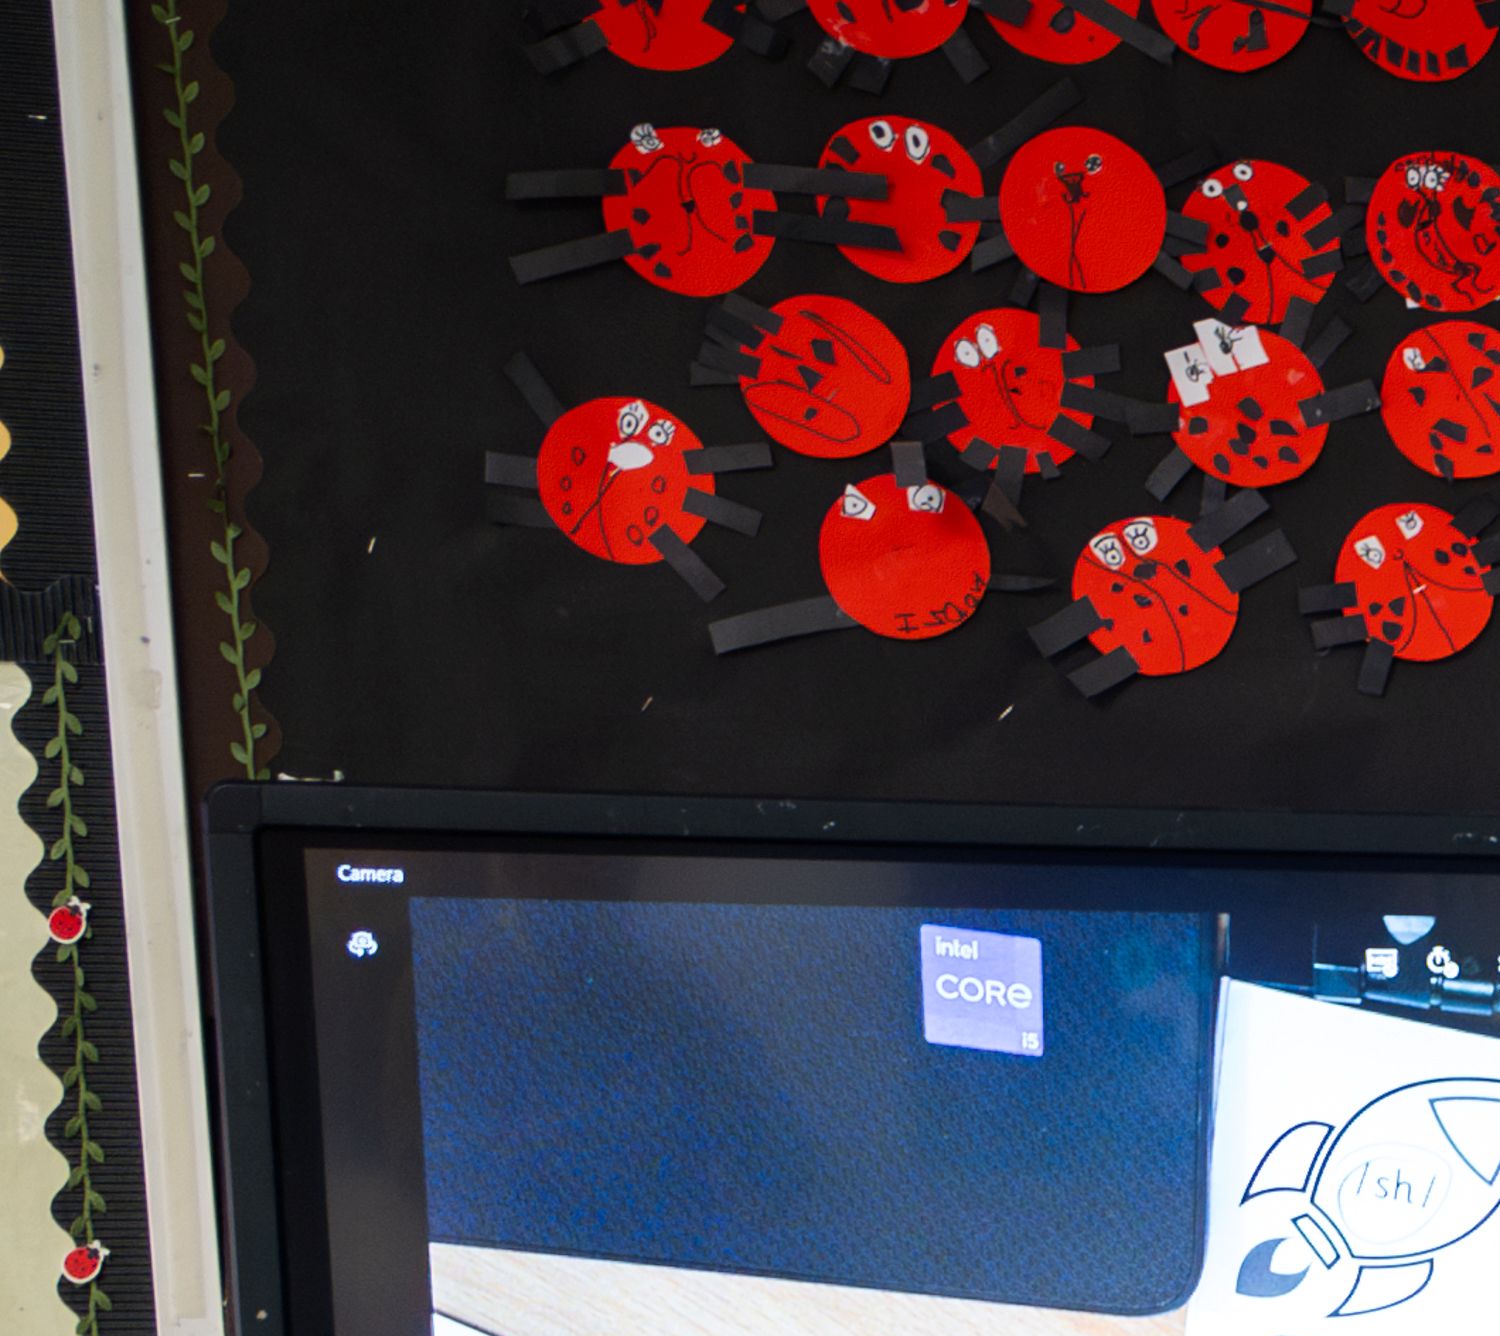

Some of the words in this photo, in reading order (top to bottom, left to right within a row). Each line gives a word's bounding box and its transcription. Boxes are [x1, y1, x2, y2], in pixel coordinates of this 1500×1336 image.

[337, 863, 405, 885] Camera
[934, 936, 979, 962] intel
[1020, 1029, 1040, 1051] i5
[1355, 1160, 1437, 1210] /sh/
